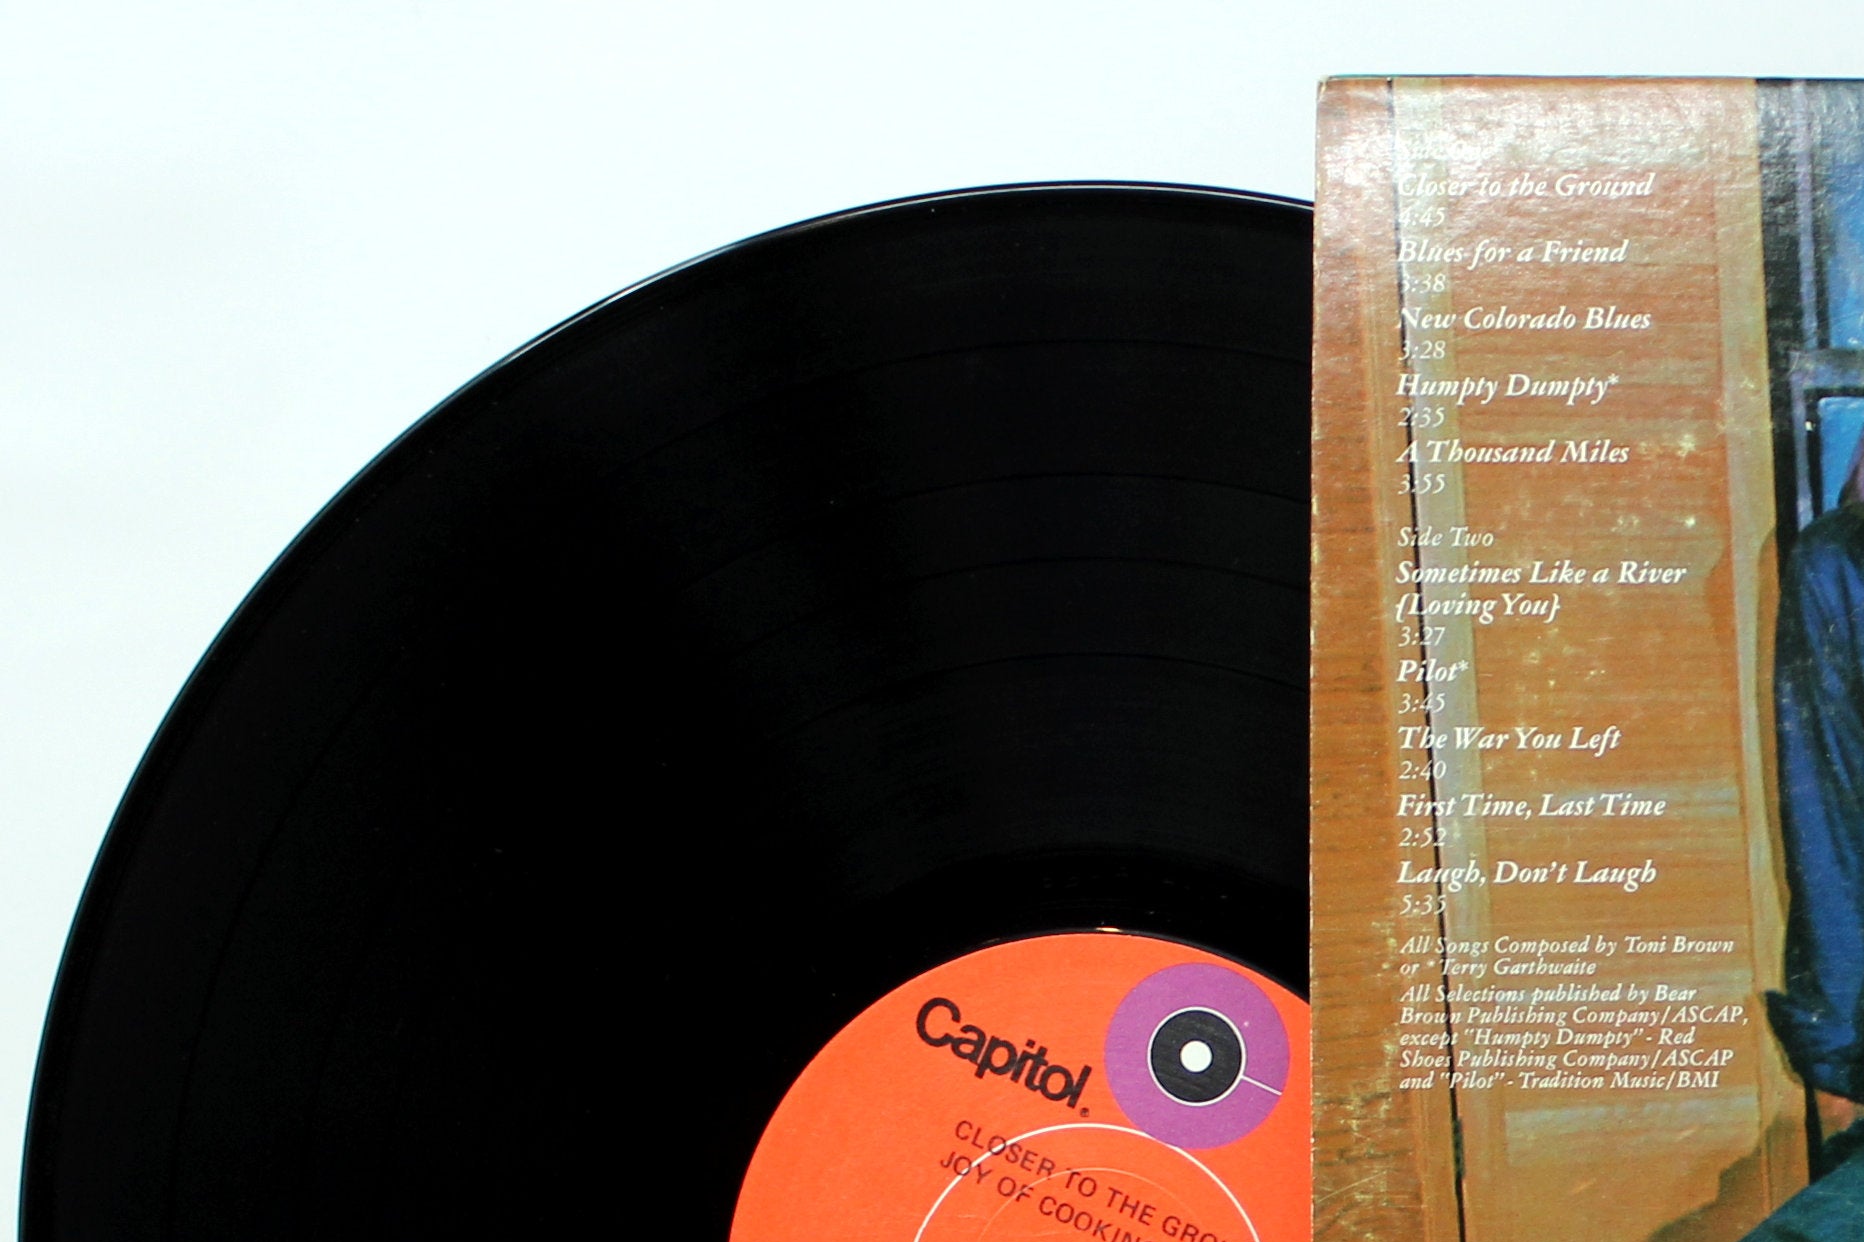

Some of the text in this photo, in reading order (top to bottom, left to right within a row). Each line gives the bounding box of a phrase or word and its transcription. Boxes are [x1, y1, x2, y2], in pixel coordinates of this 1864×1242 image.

[1397, 172, 1656, 198] Closer to the Ground
[1399, 207, 1445, 227] 4:45
[1398, 239, 1629, 270] Blues for a Friend
[1400, 274, 1446, 293] 3:38
[1396, 306, 1651, 330] New Colorado Blues
[1399, 341, 1446, 360] 3:28
[1396, 373, 1498, 406] Humpty
[1398, 407, 1445, 427] 2:35
[1396, 439, 1629, 463] A Thousand Miles
[1398, 474, 1445, 494] 3:55
[1398, 527, 1494, 547] Side Two
[1396, 560, 1686, 584] Sometimes Like a River
[1399, 627, 1445, 646] 3:27
[1399, 694, 1445, 713] 3:45
[1398, 726, 1621, 756] The War You Left
[1399, 761, 1446, 780] 2:40
[1397, 794, 1666, 819] First Time, Last Time
[1399, 828, 1446, 847] 2:52
[1397, 860, 1657, 891] Laugh, Don't Laugh
[1400, 895, 1446, 914] 5:35
[1400, 936, 1734, 955] All Songs Composed by Toni Brown
[1400, 1050, 1734, 1070] Shoes Publishing Company/ASCAP
[941, 1151, 992, 1185] JOY
[996, 1176, 1034, 1202] OF
[954, 1120, 1056, 1181] CLOSER
[1063, 1168, 1097, 1198] TO
[1106, 1187, 1157, 1225] THE
